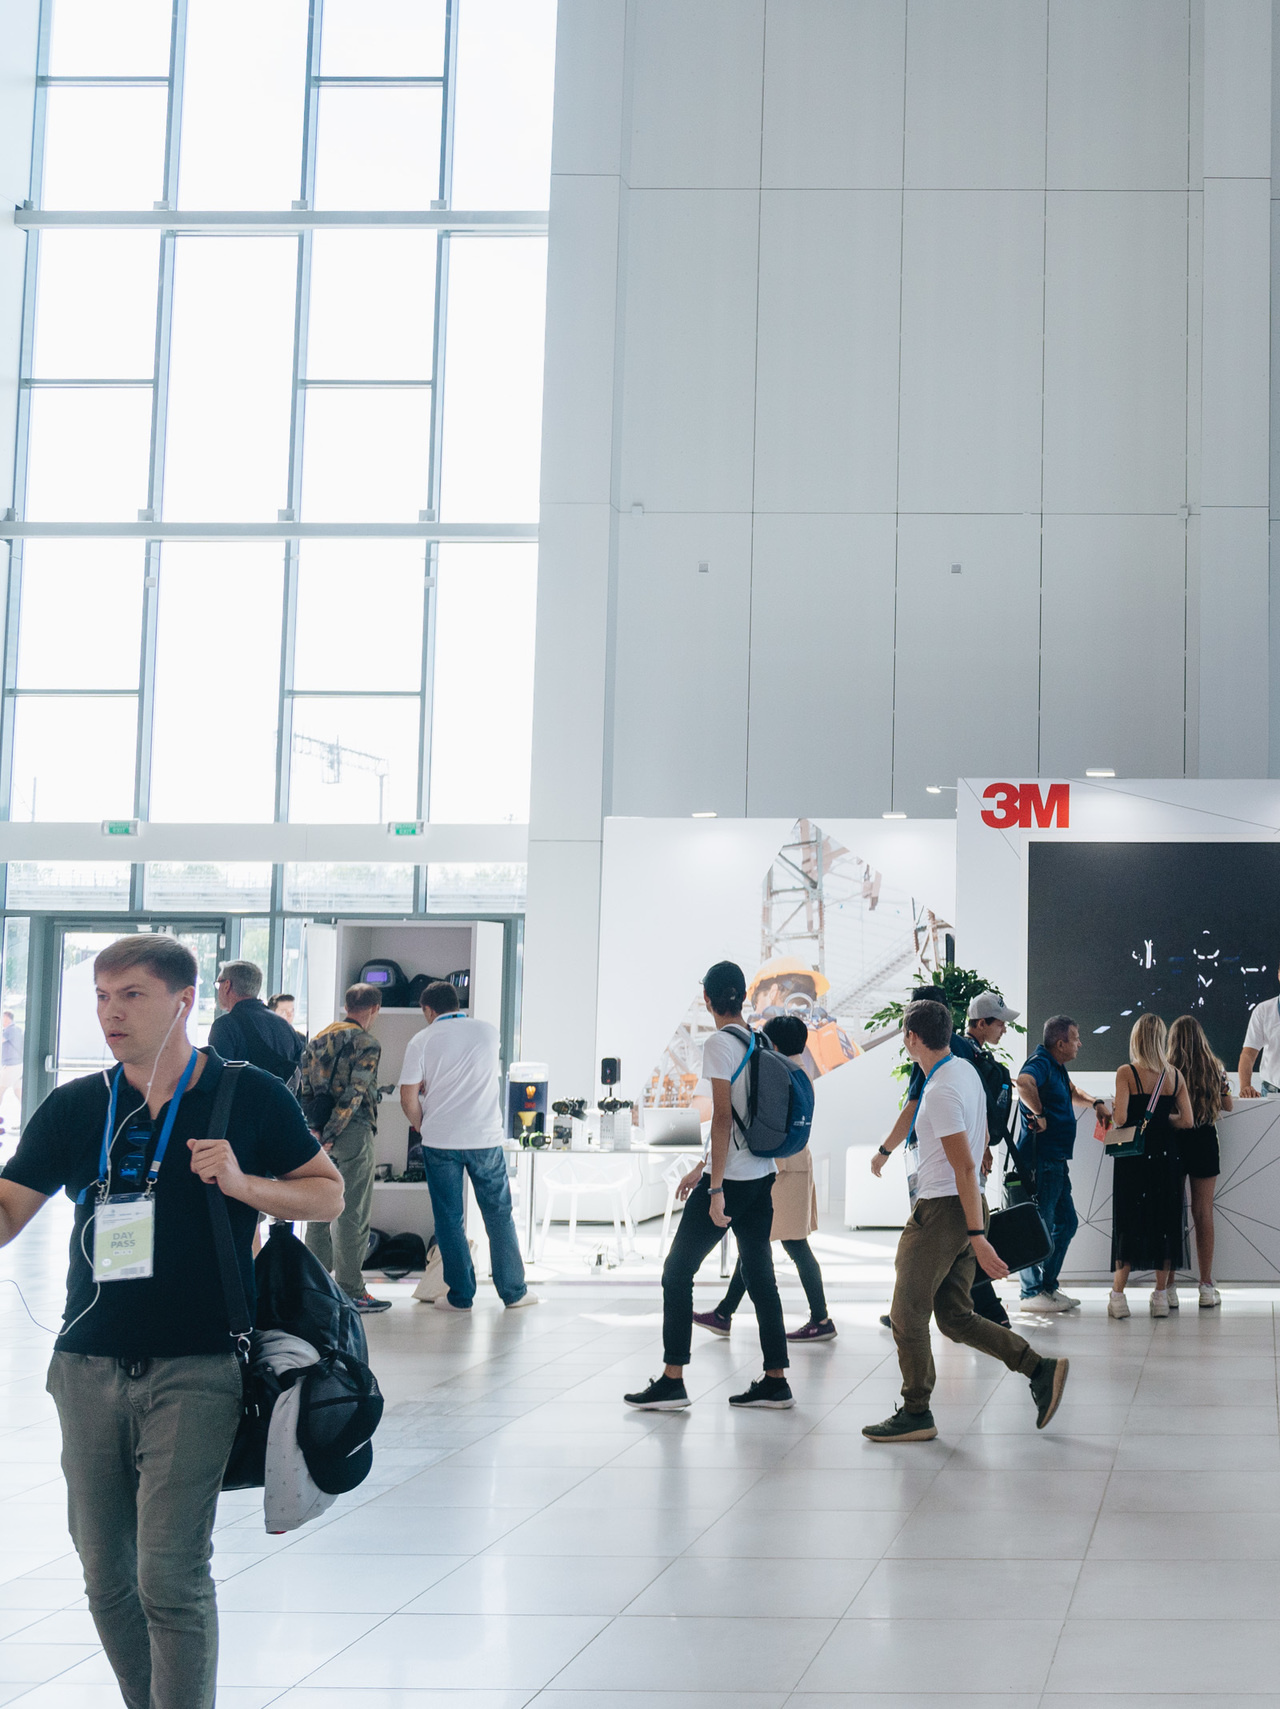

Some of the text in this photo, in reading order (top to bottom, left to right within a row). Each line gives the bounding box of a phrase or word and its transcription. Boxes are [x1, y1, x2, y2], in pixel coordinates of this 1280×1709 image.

[980, 782, 1070, 829] 3M
[112, 1231, 134, 1240] DAY
[110, 1239, 136, 1249] PASS
